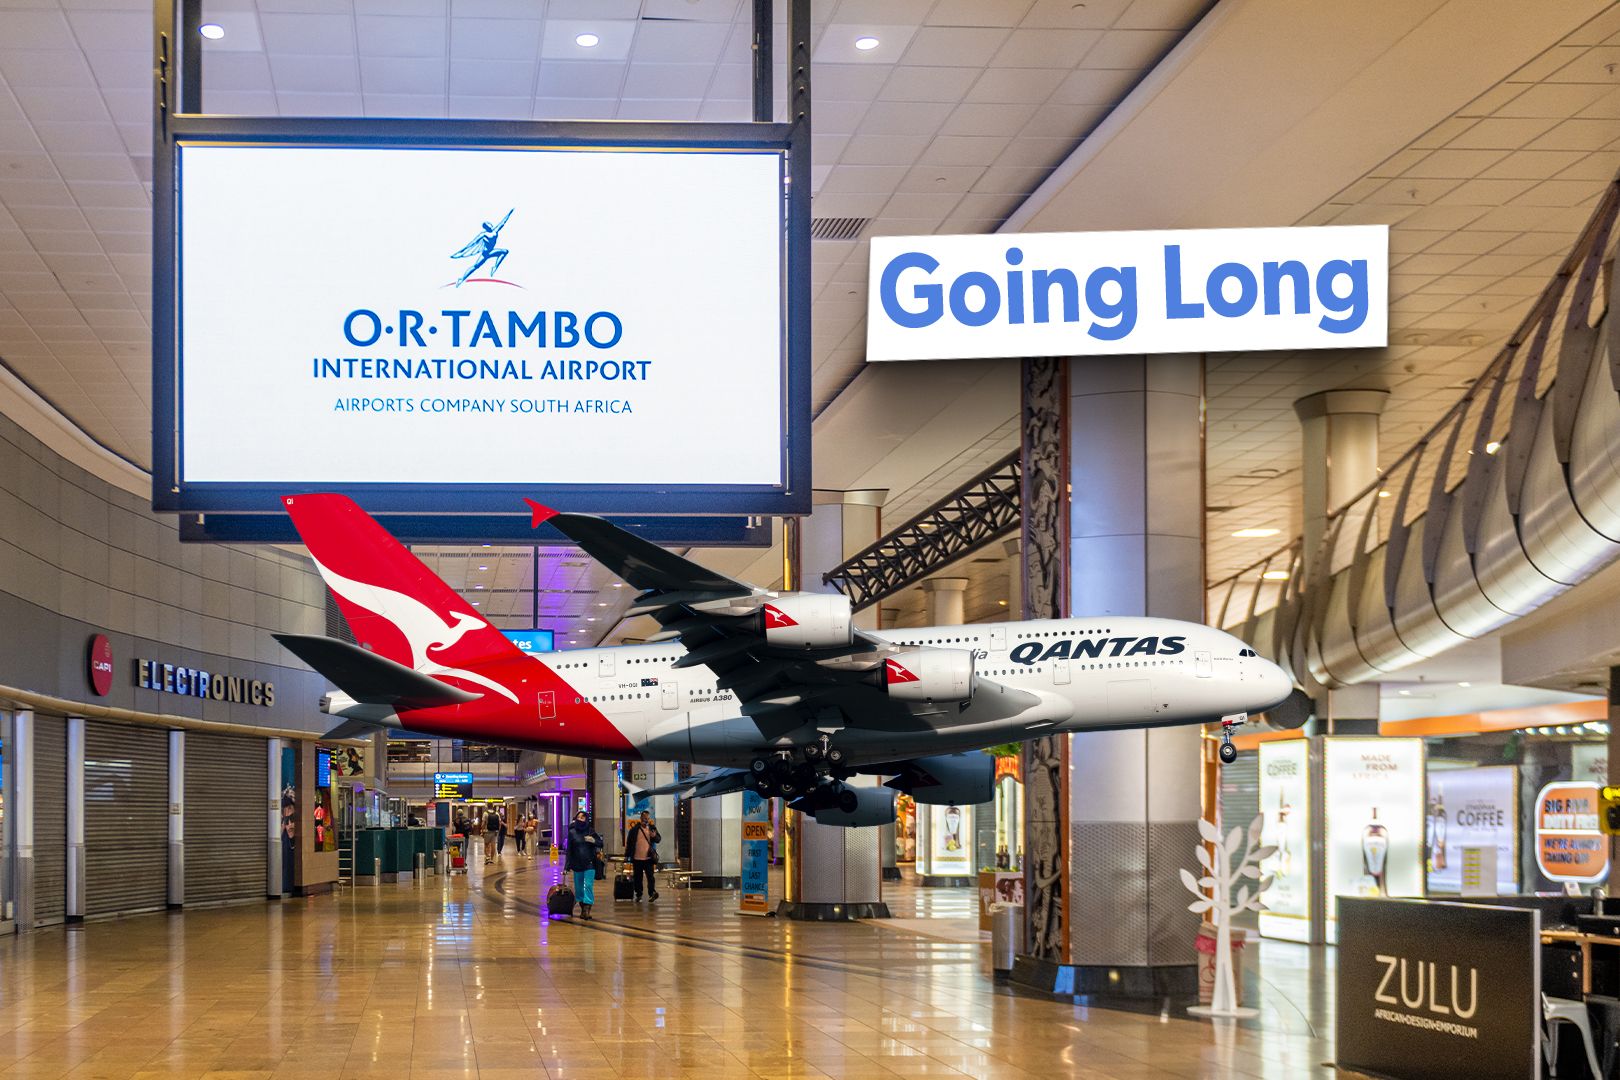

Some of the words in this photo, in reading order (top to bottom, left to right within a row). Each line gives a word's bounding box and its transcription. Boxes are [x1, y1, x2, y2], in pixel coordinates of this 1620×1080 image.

[313, 358, 533, 380] INTERNATIONAL
[540, 360, 652, 381] AIRPORT
[334, 398, 414, 413] AIRPORTS
[420, 398, 506, 413] COMPANY
[510, 399, 569, 414] SOUTH
[574, 399, 633, 414] AFRICA
[1009, 636, 1187, 666] QANTAS
[93, 660, 112, 673] CAPI
[137, 658, 276, 708] ELECTRONICS
[713, 694, 733, 702] A380
[1366, 763, 1398, 771] FROM
[1456, 809, 1504, 827] COFFEE
[745, 825, 766, 837] OPEN
[748, 849, 762, 857] FIRST
[748, 872, 761, 880] LAST
[744, 882, 765, 891] CHANCE
[1375, 954, 1477, 1019] ZULU
